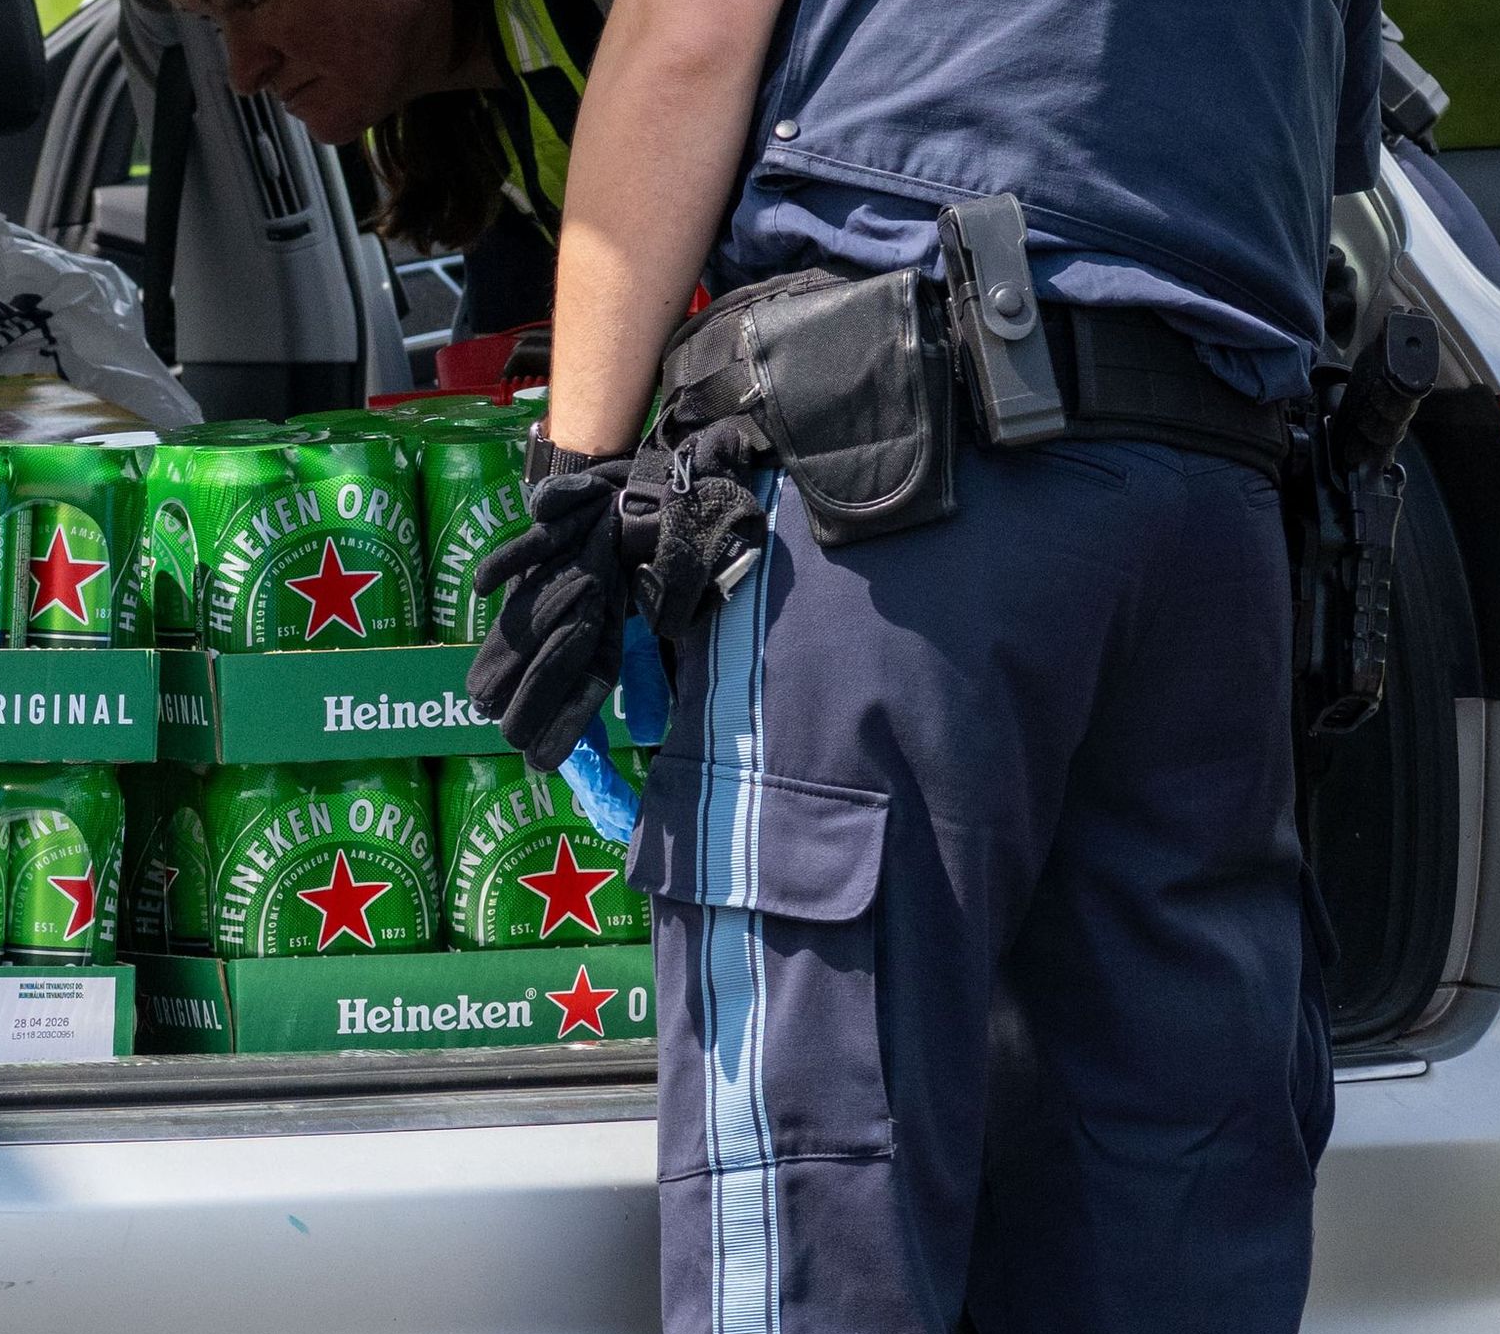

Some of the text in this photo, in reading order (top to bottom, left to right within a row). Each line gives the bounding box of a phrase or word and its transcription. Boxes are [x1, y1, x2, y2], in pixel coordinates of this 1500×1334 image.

[209, 490, 321, 634] HEINEKEN
[371, 617, 396, 630] 1873
[219, 802, 333, 944] HEINEKEN
[606, 915, 633, 926] 1873
[381, 927, 406, 939] 1873
